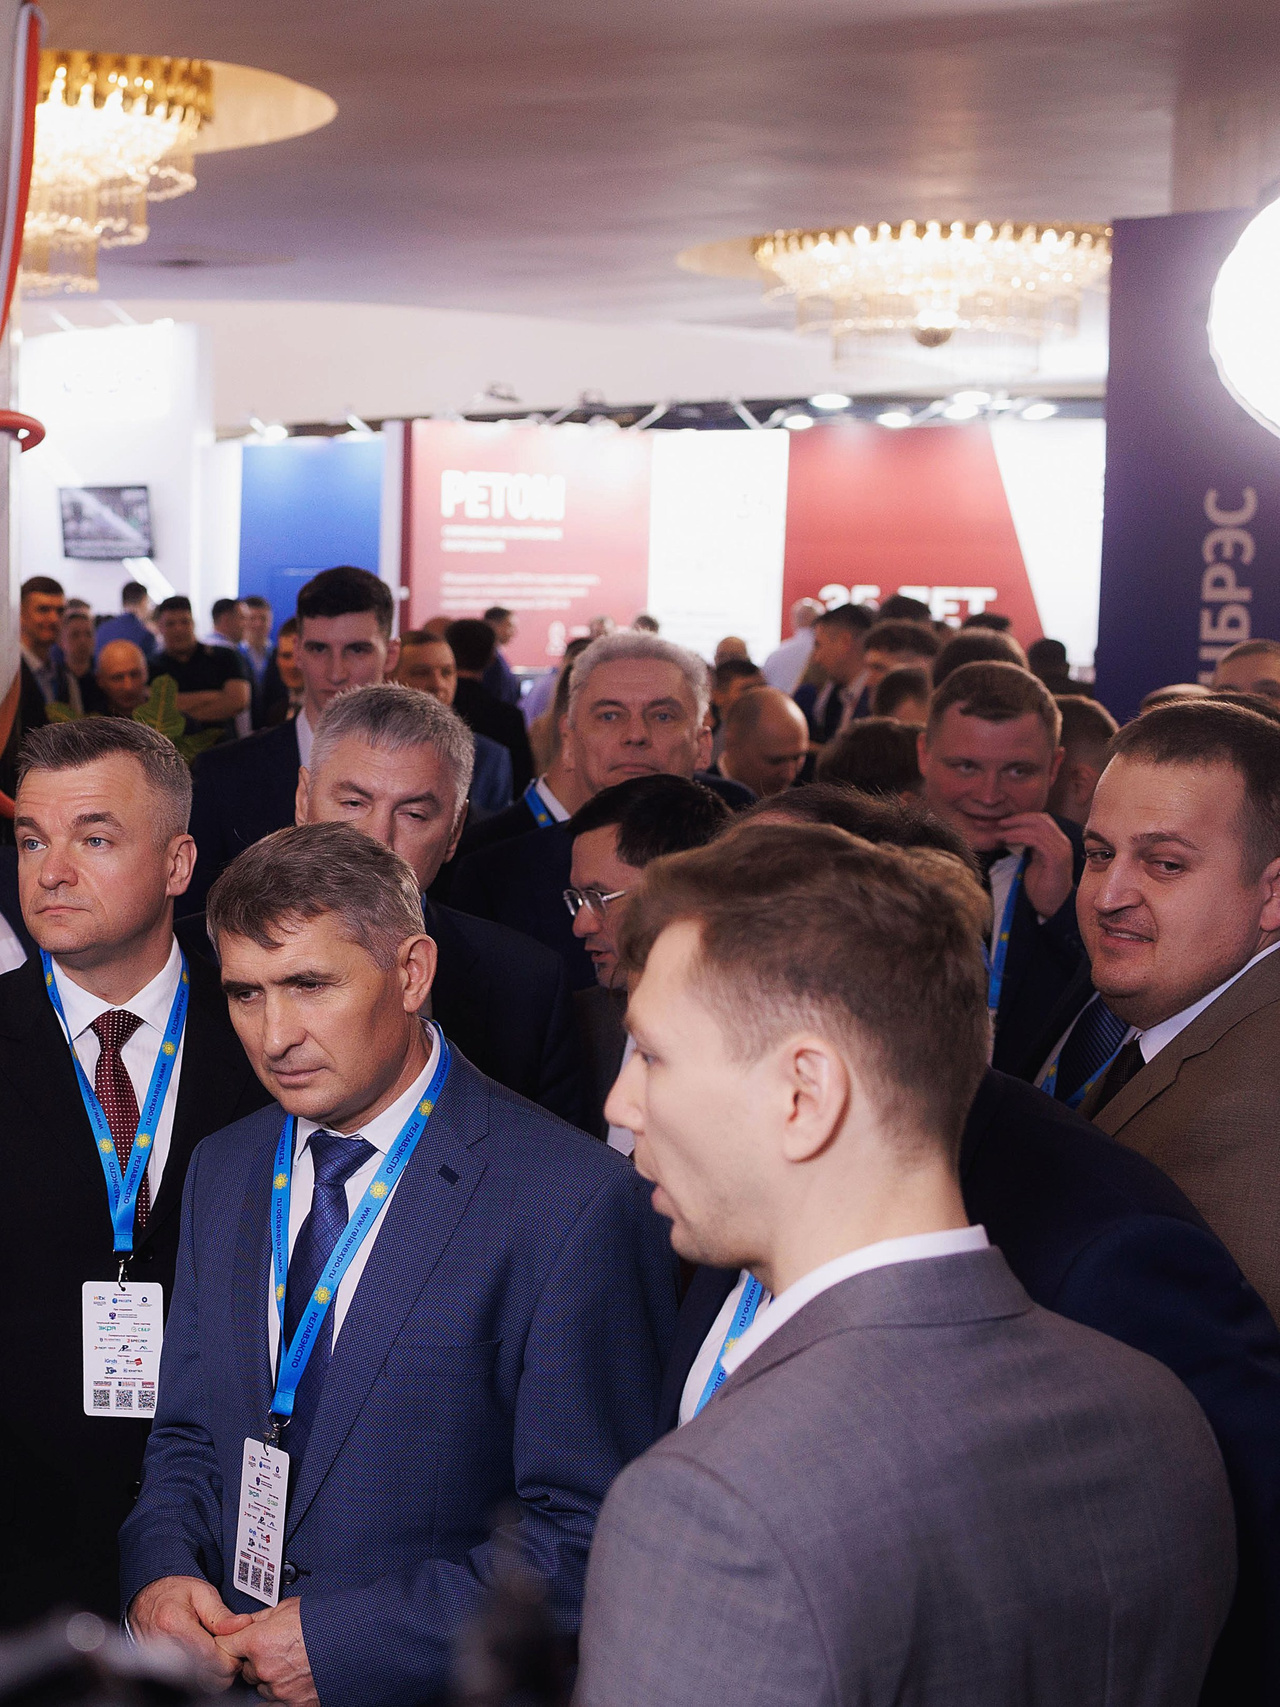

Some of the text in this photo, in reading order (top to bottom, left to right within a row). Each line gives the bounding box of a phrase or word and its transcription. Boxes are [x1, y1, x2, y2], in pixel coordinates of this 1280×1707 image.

[145, 1062, 167, 1126] www.relavexpo.ru
[385, 1121, 420, 1175] РЕЛАВЭКСПО
[108, 1161, 122, 1209] АВЭКСПО
[124, 1154, 143, 1205] РЕЛАВЭКСПО
[327, 1206, 372, 1281] www.relavexpo.ru
[291, 1310, 318, 1369] РЕЛАВЭКСПО
